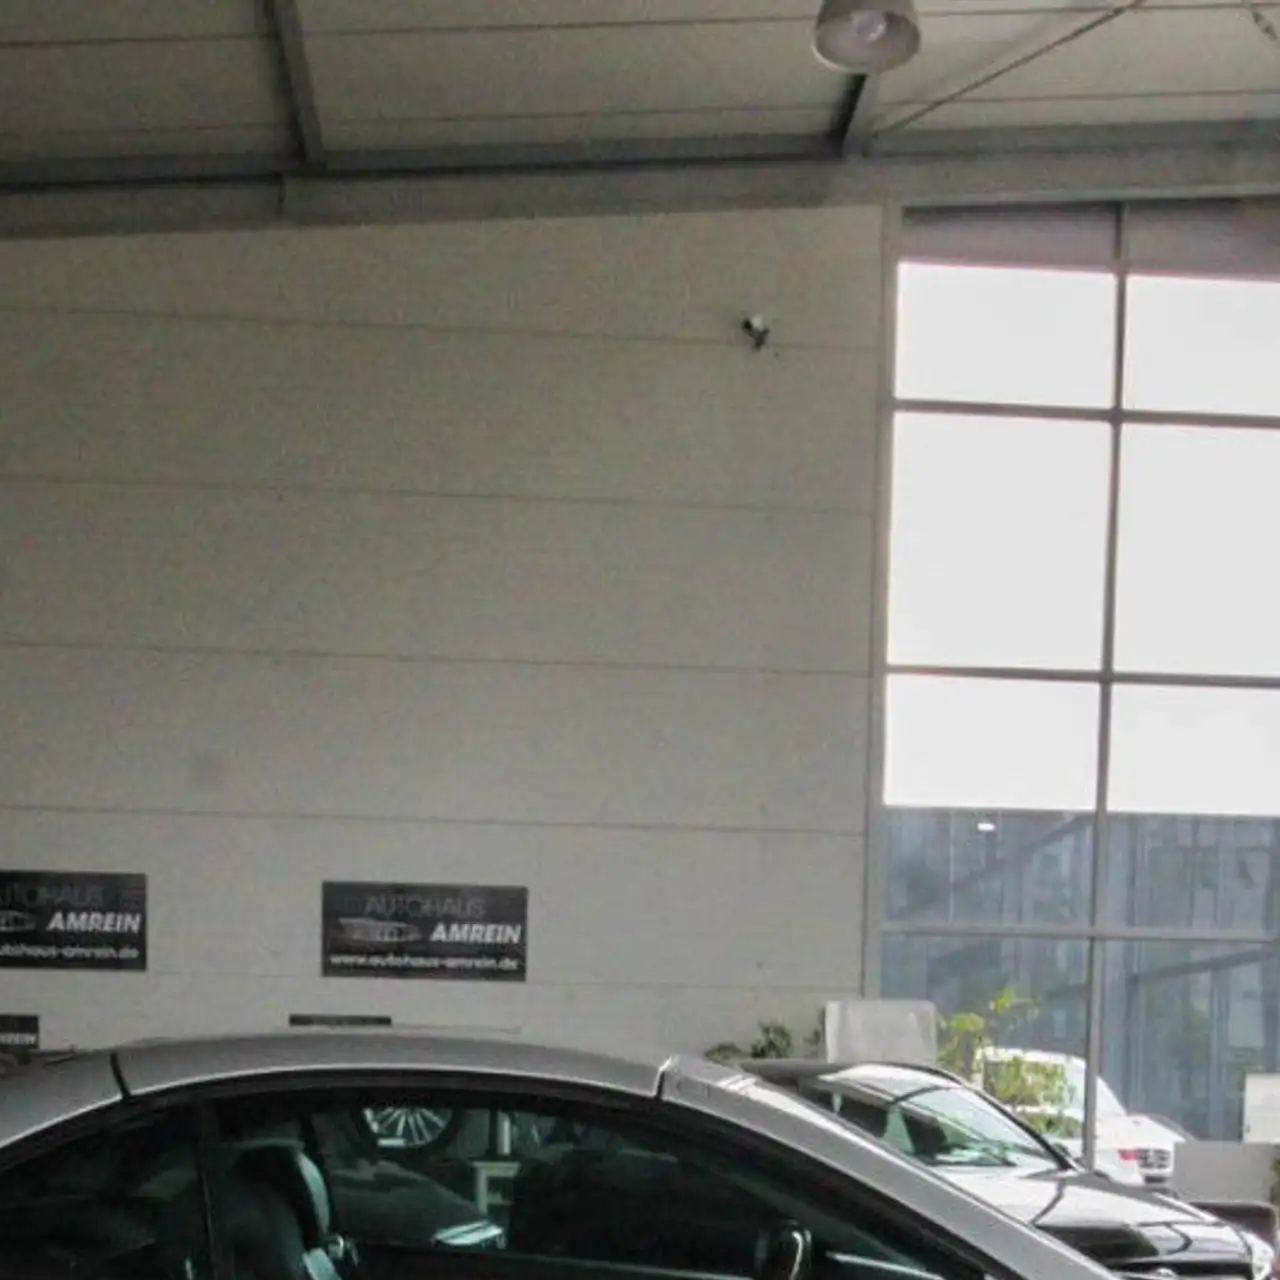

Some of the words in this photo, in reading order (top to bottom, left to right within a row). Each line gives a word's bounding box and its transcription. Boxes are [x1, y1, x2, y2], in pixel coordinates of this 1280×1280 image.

[364, 895, 488, 918] AUTOHAUS
[45, 911, 142, 934] AMREIN
[429, 923, 522, 945] AMREIN
